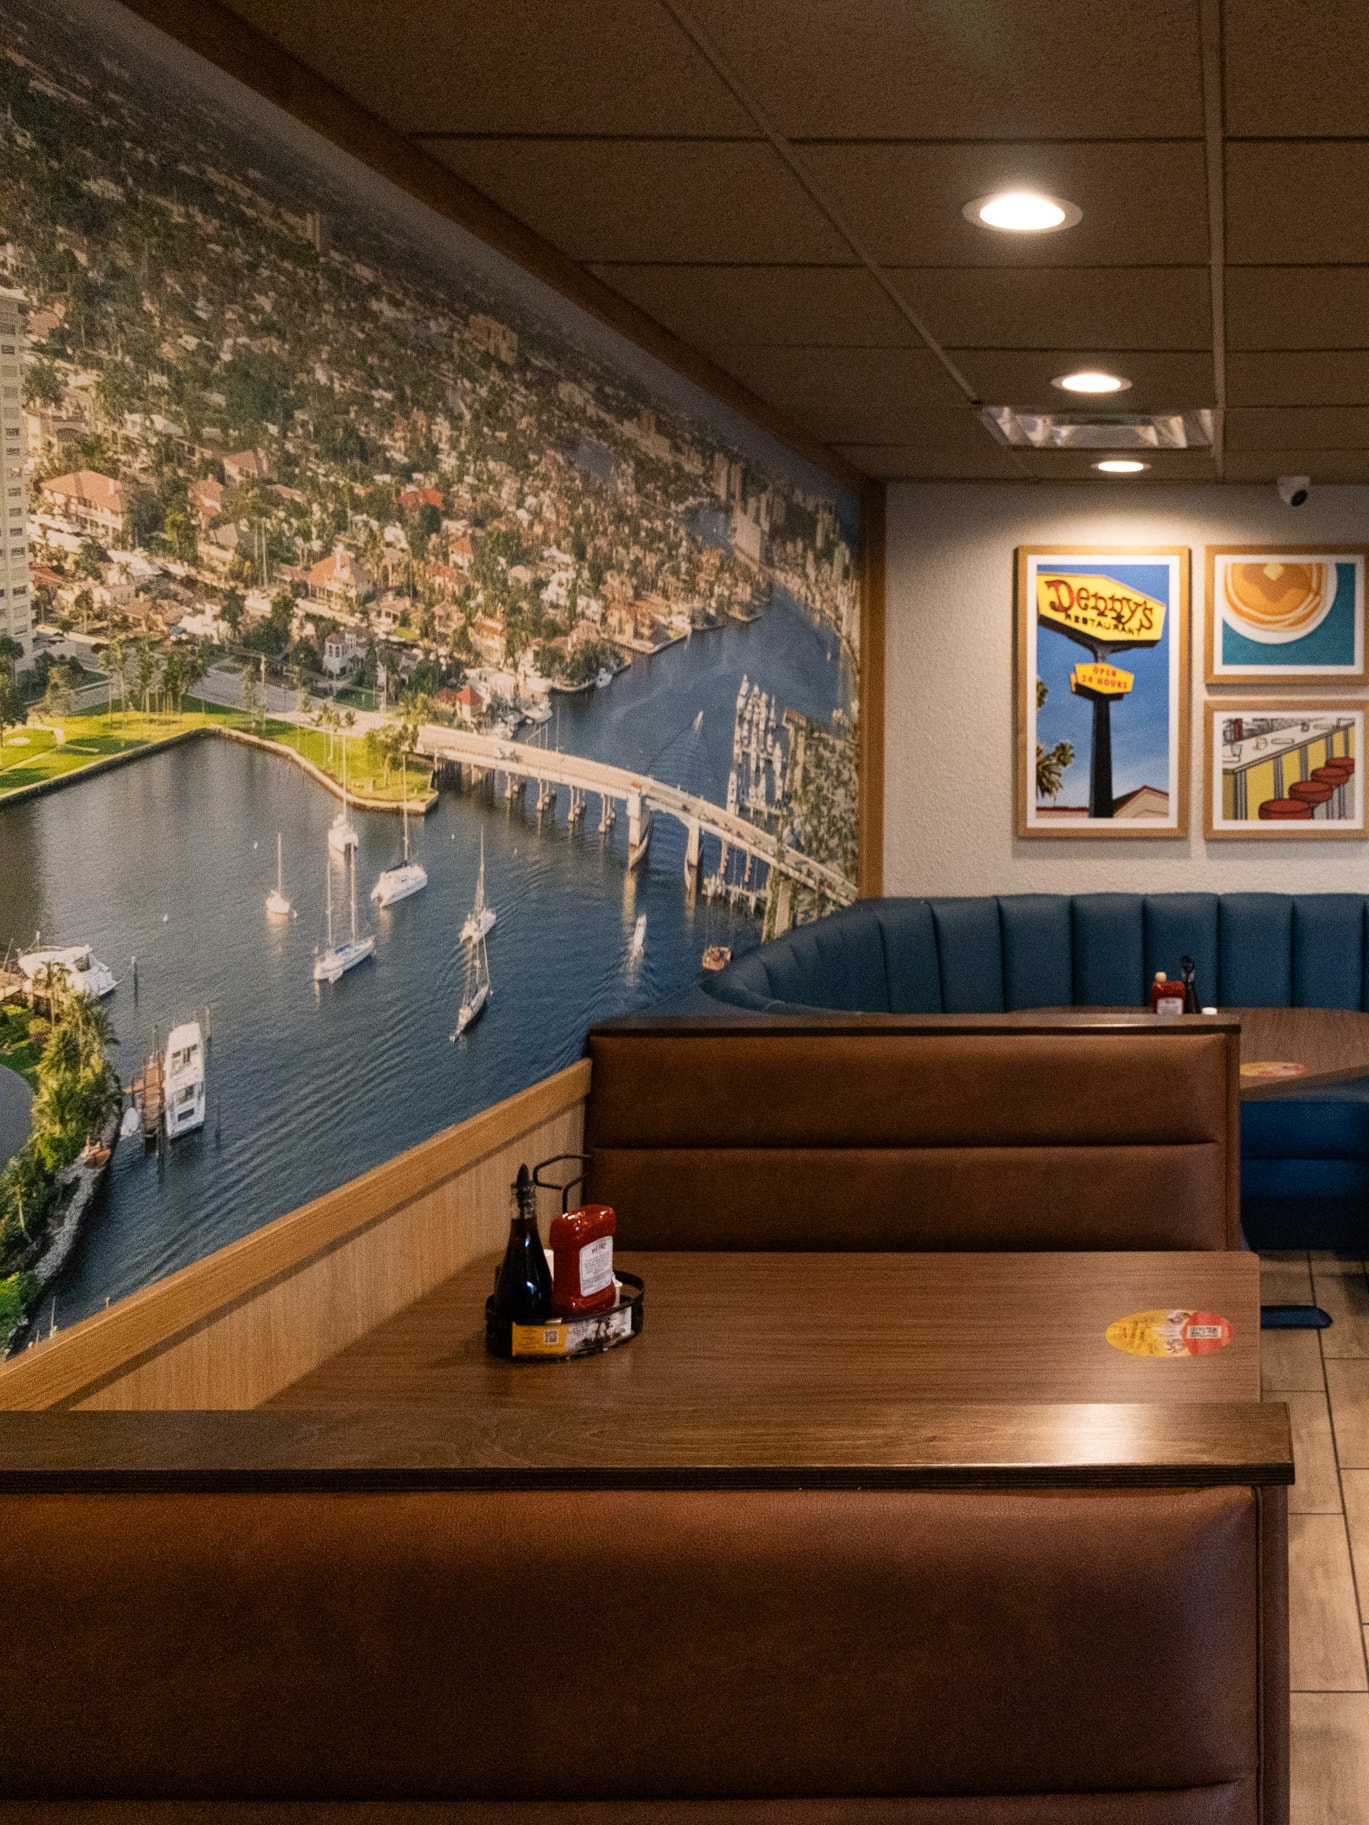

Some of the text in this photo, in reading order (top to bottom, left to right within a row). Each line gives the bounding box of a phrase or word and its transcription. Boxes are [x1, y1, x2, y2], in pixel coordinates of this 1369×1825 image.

[1044, 579, 1154, 630] Denny's
[1065, 610, 1142, 637] RESTAURANT
[1092, 665, 1118, 678] OPEN
[1096, 678, 1128, 689] HOURS
